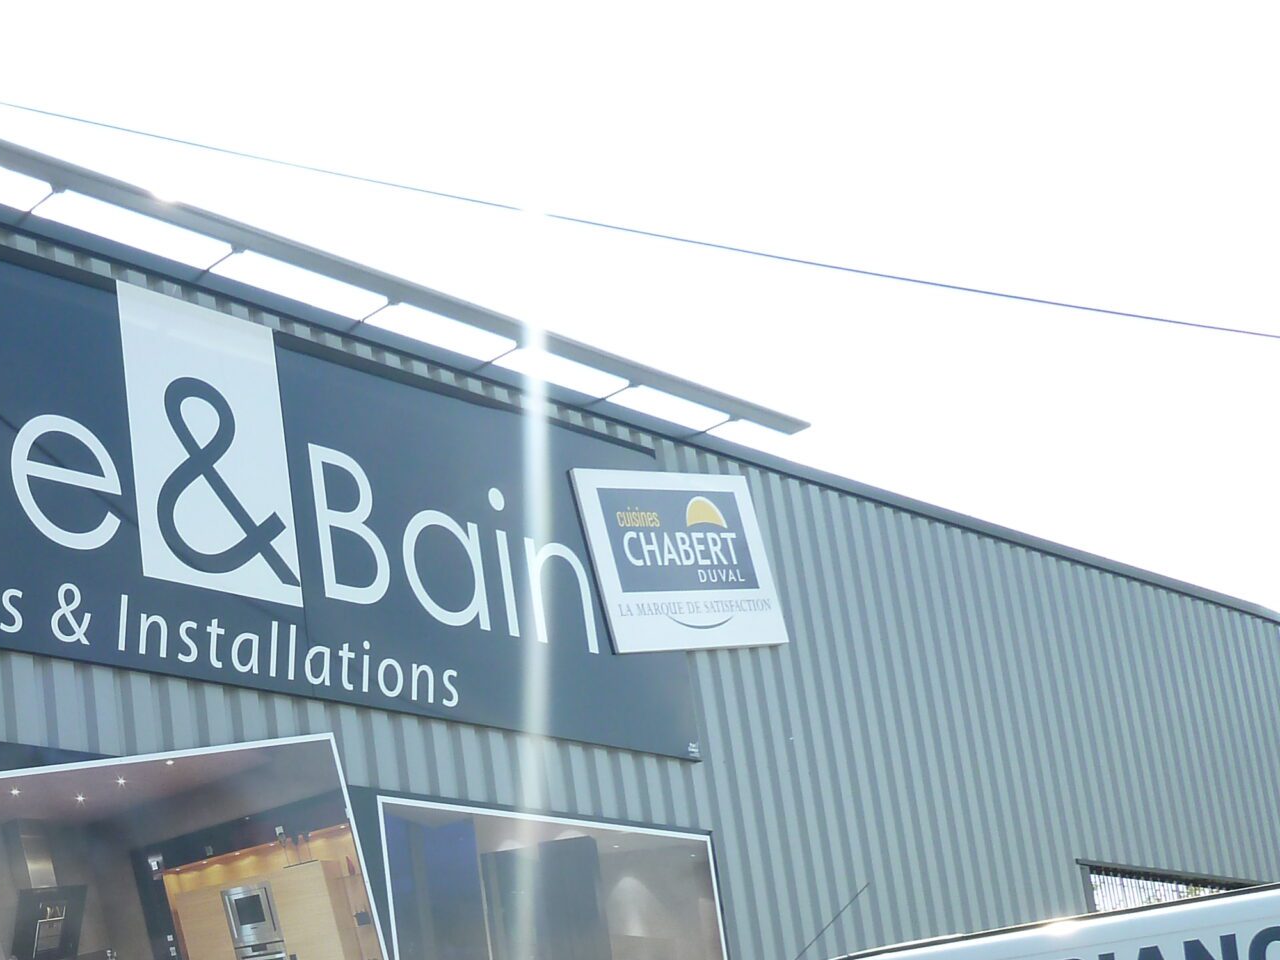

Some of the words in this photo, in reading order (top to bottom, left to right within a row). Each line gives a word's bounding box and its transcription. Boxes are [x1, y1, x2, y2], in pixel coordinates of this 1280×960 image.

[157, 376, 301, 588] &
[308, 442, 599, 654] Bain
[616, 506, 660, 528] cuisines
[623, 531, 738, 566] CHABERT
[698, 569, 746, 583] DUVAL
[618, 603, 634, 617] LA
[636, 601, 686, 617] MARQUE
[687, 601, 703, 615] DE
[704, 598, 773, 614] SATISFACTION
[50, 582, 92, 645] &
[118, 594, 460, 708] Installations
